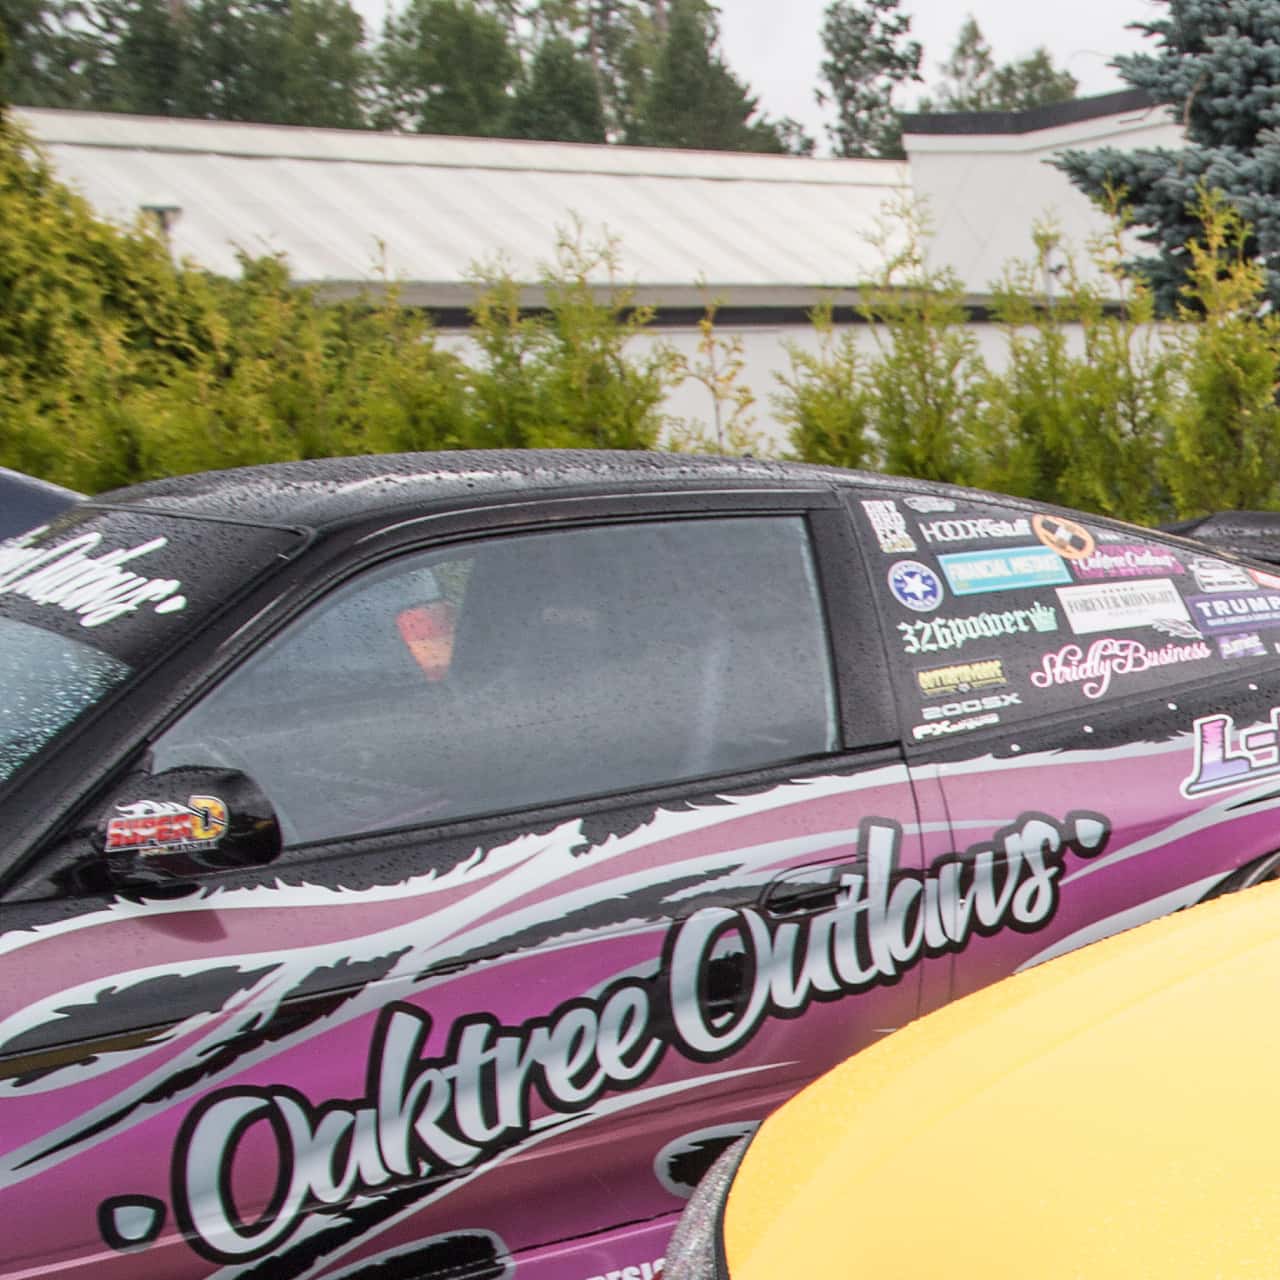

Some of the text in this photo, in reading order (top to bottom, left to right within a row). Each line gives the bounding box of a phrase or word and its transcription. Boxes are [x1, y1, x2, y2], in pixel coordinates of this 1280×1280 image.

[1112, 640, 1212, 674] Business
[921, 693, 1023, 720] 200SX
[180, 820, 1061, 1259] Oaktree Outlaws
